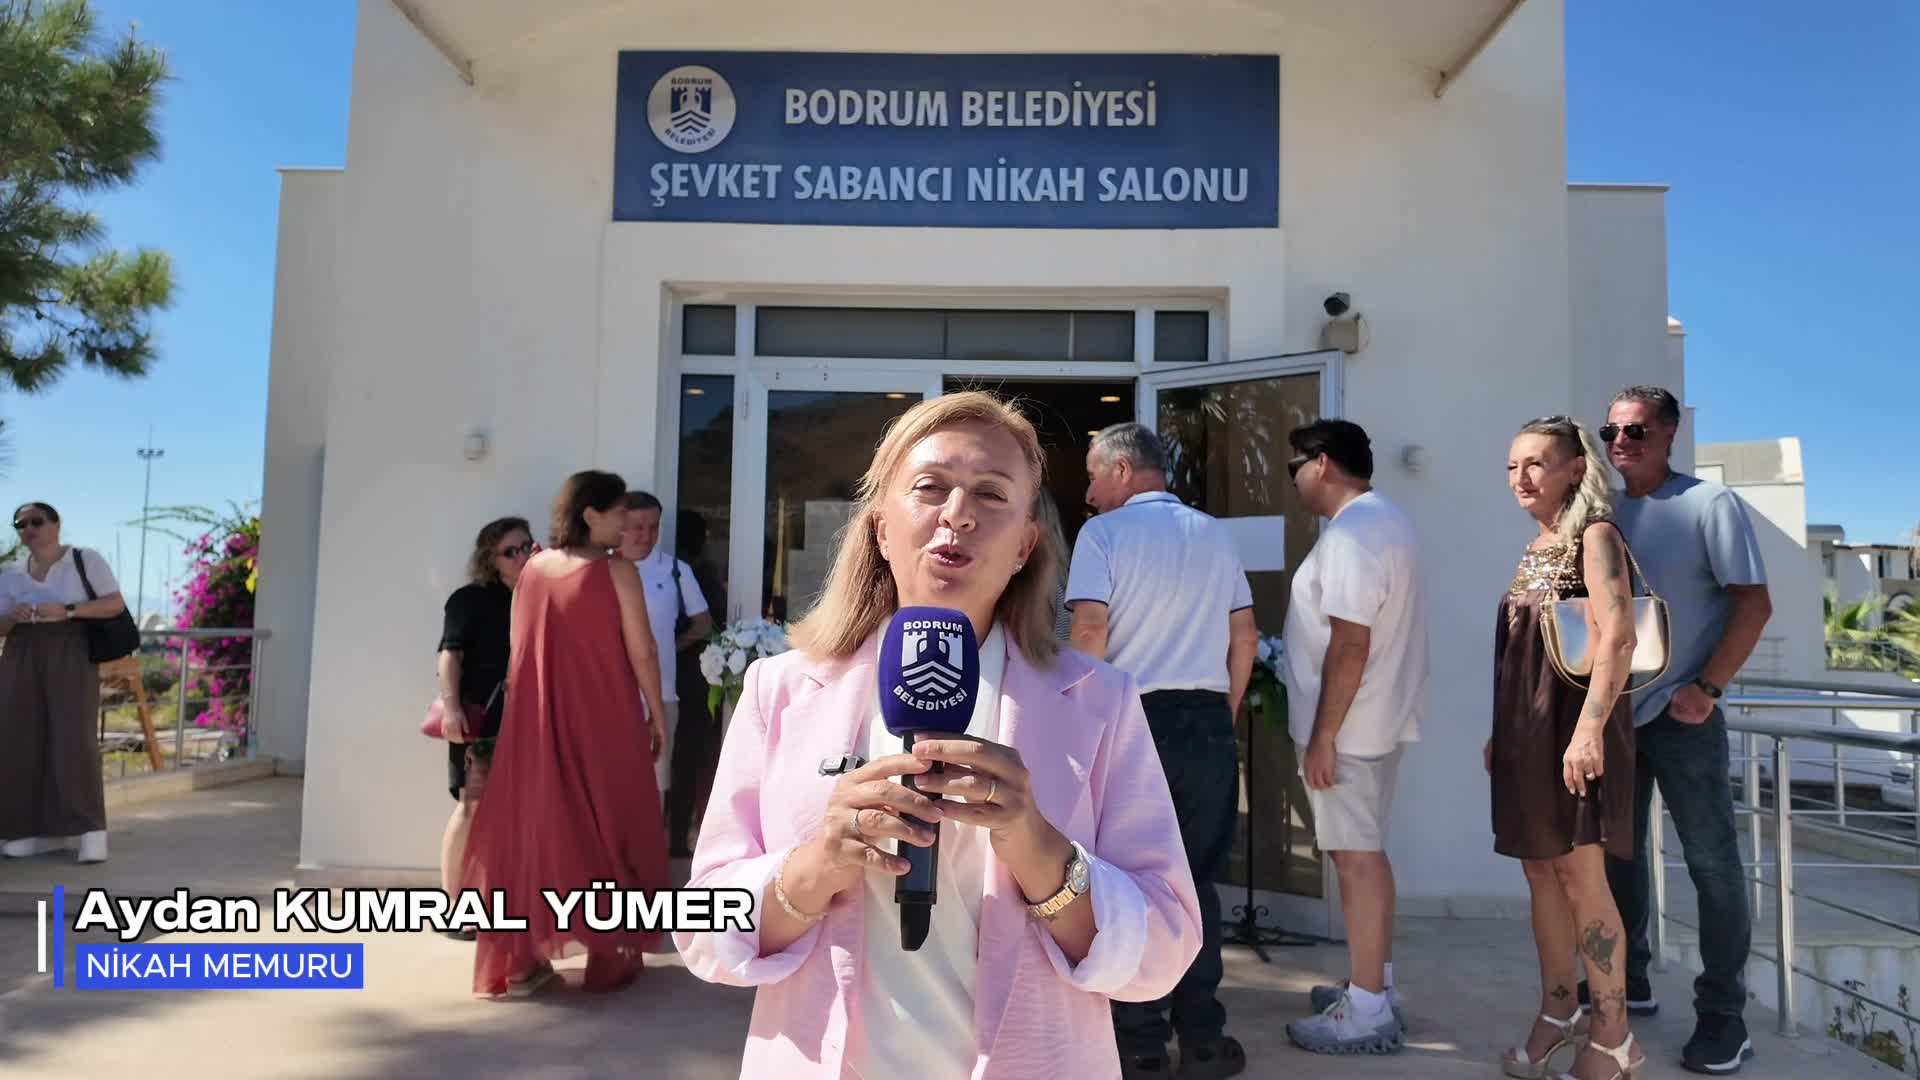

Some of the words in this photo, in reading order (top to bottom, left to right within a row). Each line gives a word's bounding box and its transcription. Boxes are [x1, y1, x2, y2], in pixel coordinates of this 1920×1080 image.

[785, 88, 948, 126] BODRUM
[961, 80, 1156, 126] BELEDİYESİ
[650, 162, 782, 207] ŞEVKET
[793, 165, 952, 201] SABANCI
[967, 157, 1085, 201] NİKAH
[1099, 166, 1248, 202] SALONU
[903, 620, 963, 633] BODRUM
[893, 685, 968, 711] BELEDİYESİ
